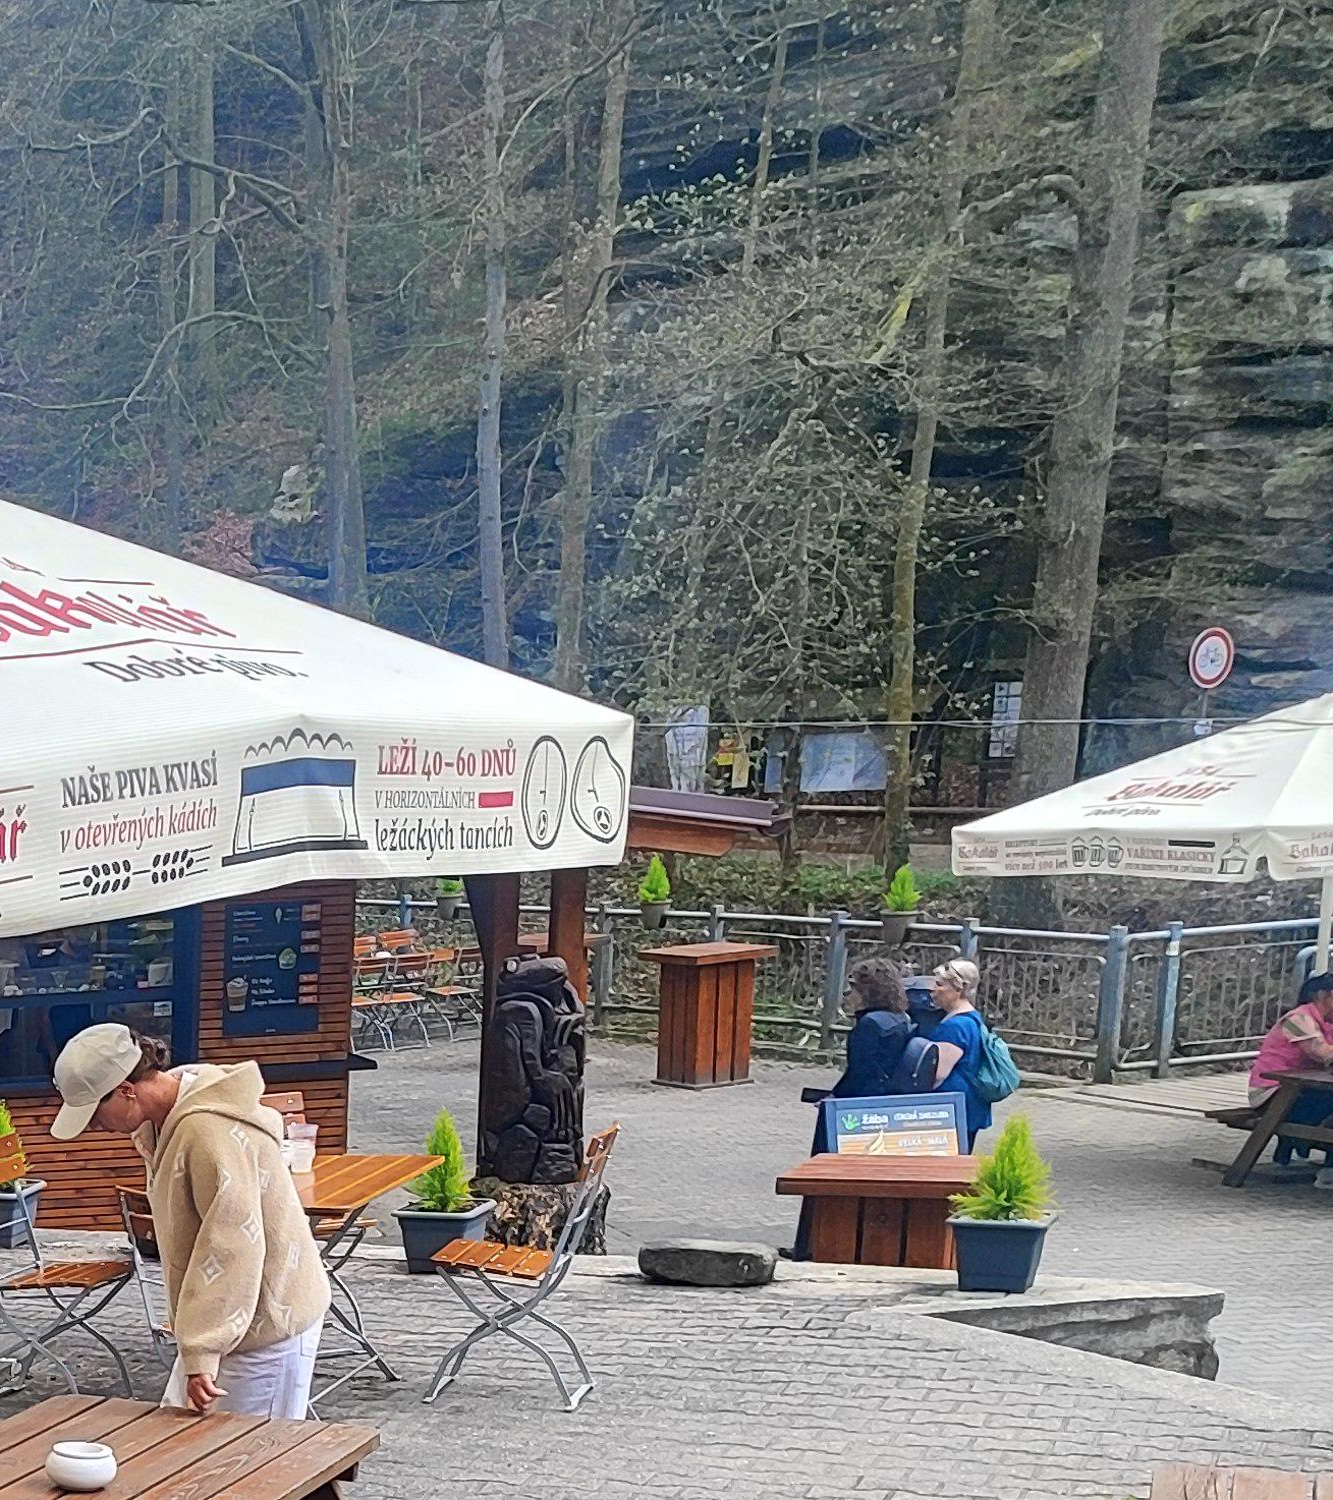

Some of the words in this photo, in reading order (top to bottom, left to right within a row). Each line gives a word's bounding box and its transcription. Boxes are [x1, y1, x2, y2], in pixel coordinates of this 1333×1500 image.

[82, 647, 222, 682] Dobré
[60, 765, 114, 809] NAŠE
[117, 762, 162, 800] PIVA
[163, 749, 218, 792] KVASÍ
[376, 736, 418, 776] LEŽÍ
[480, 737, 517, 778] DNŮ
[374, 790, 383, 809] V
[385, 786, 476, 809] HORIZONTÁLNÍCH
[60, 829, 71, 853] v
[74, 804, 165, 850] otevřených
[167, 797, 217, 836] kádích
[374, 817, 455, 861] ležáckých
[459, 815, 513, 851] tancích
